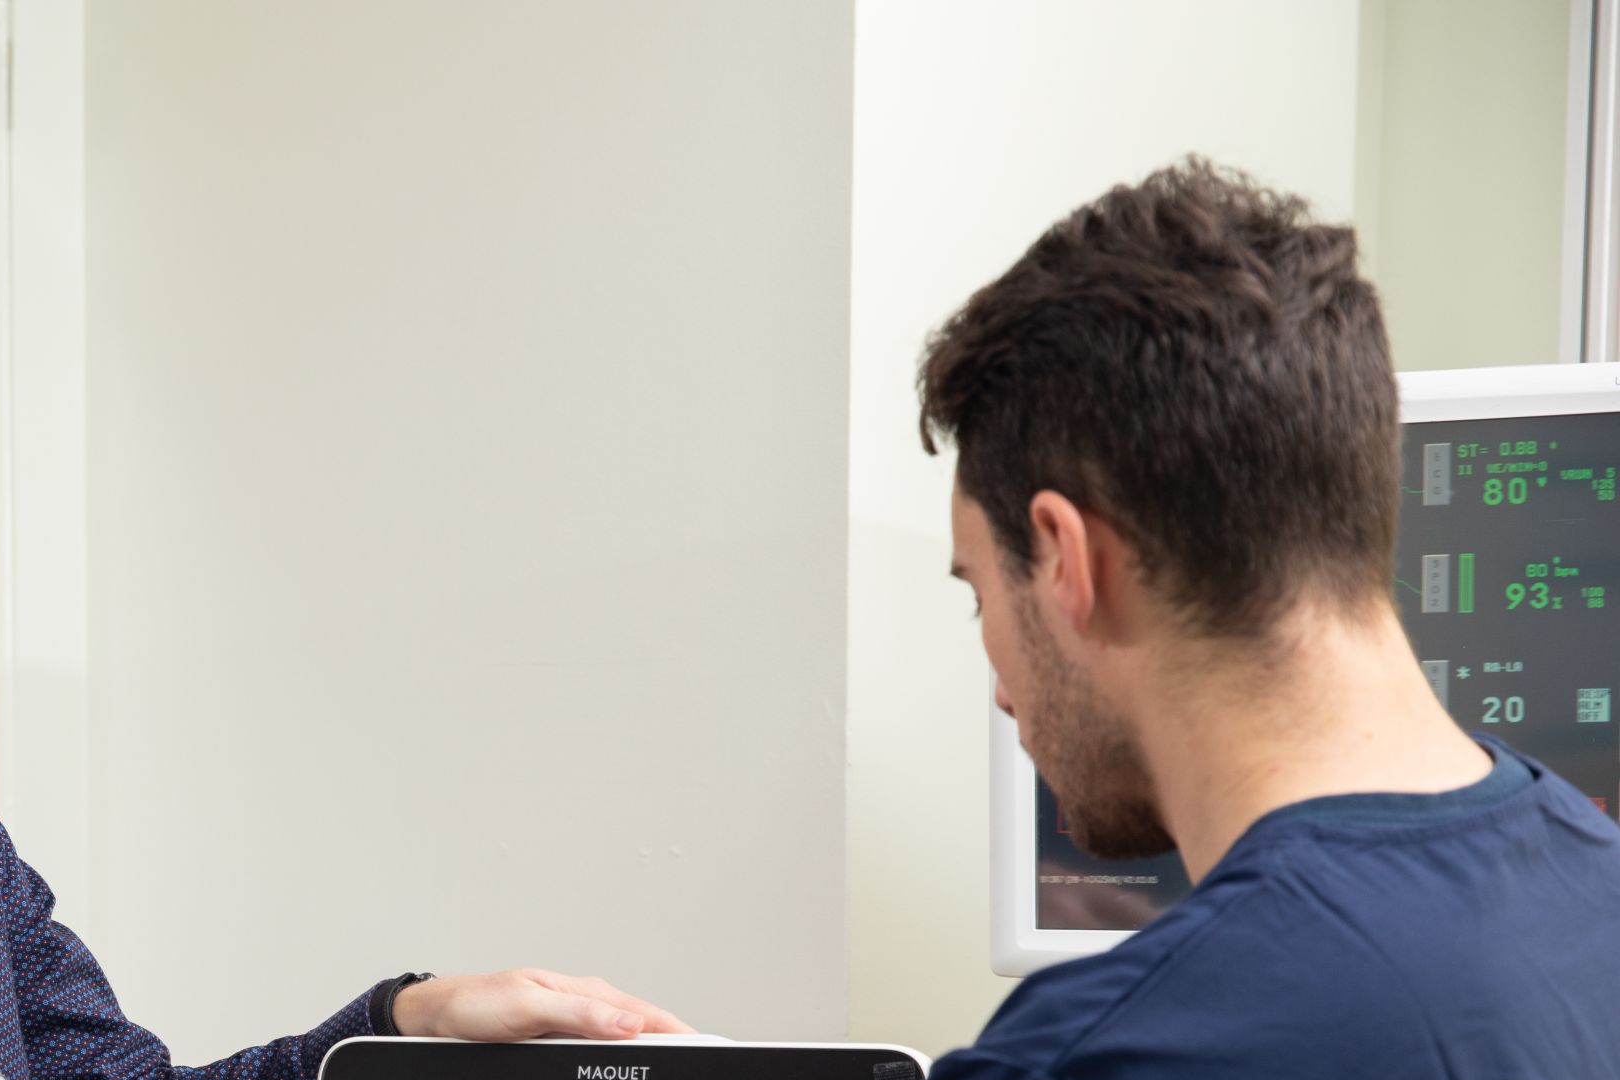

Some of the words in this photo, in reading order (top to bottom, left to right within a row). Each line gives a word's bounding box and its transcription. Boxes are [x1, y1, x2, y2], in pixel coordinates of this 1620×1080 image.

[1483, 478, 1527, 506] 80
[1525, 563, 1548, 577] 80
[1482, 696, 1524, 723] 20
